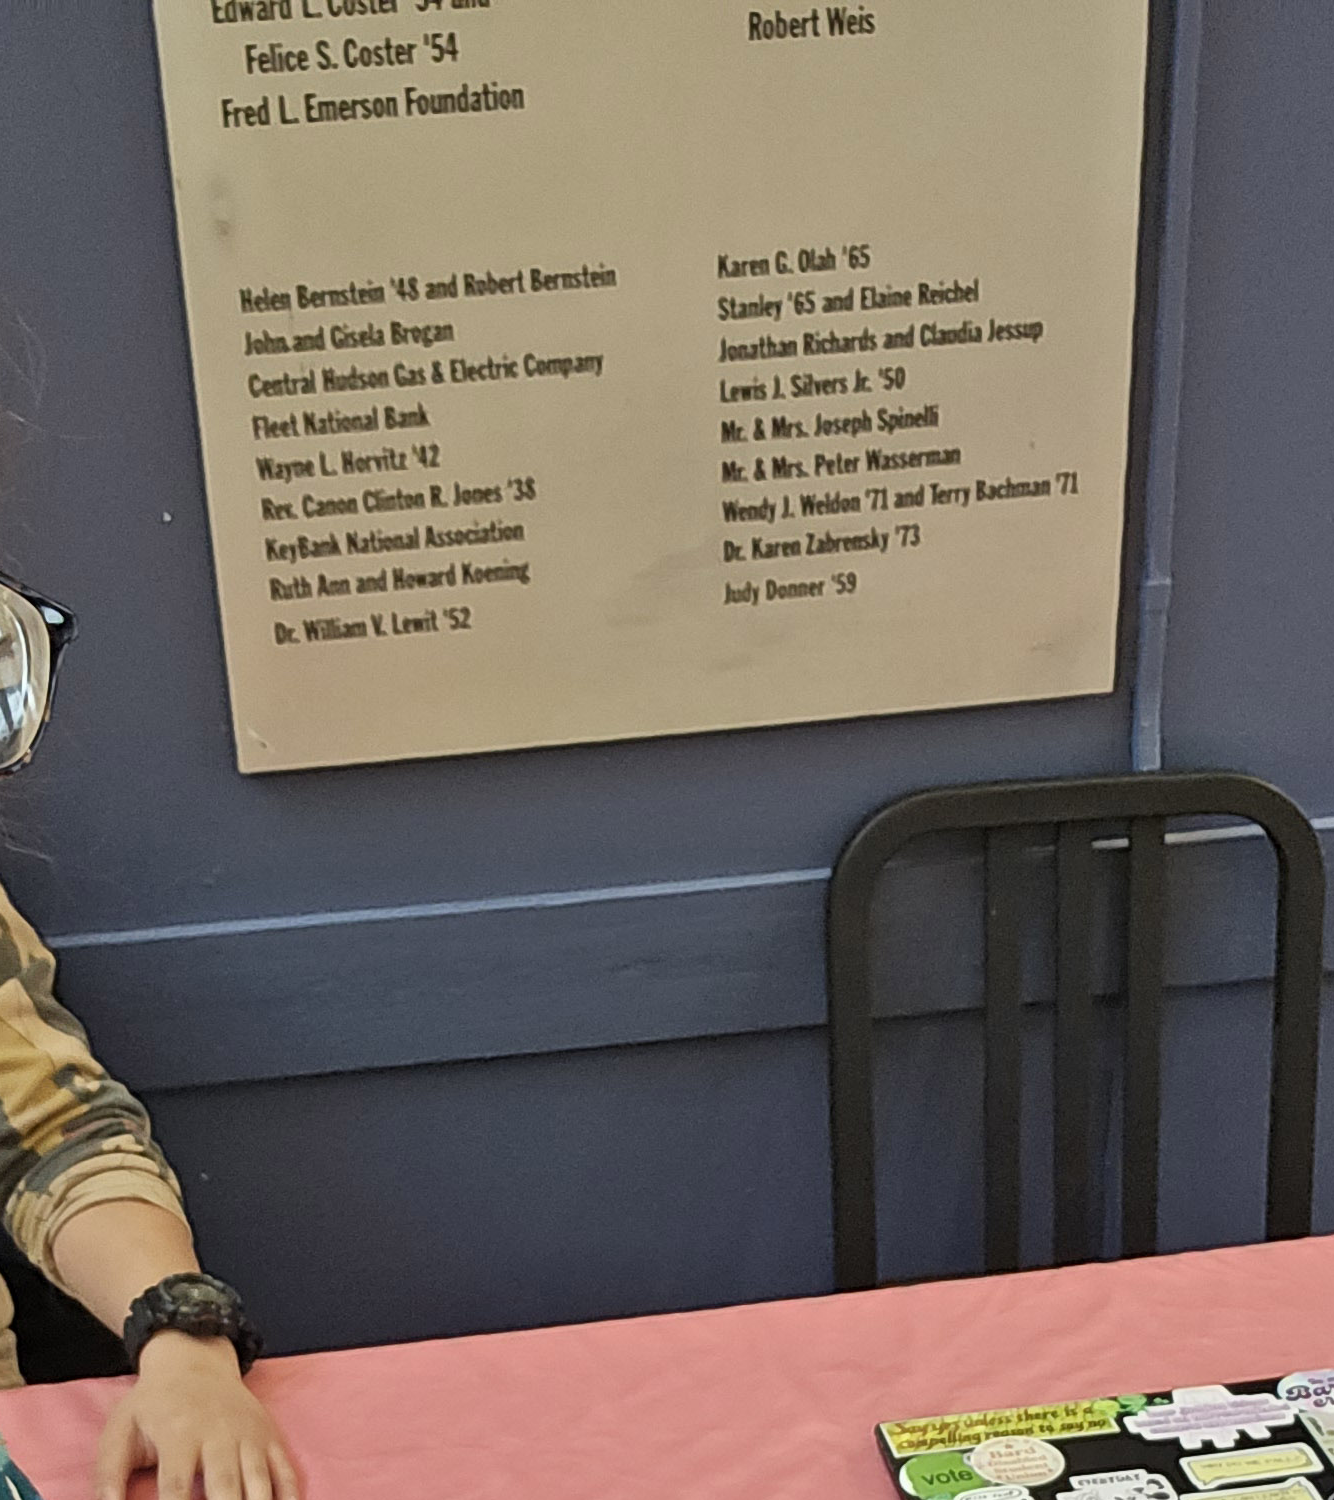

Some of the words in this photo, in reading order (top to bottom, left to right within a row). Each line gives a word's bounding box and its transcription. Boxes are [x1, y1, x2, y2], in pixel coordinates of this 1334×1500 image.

[748, 9, 820, 41] Robert
[826, 5, 875, 36] Weis
[245, 43, 309, 74] Felice
[316, 40, 339, 69] S.
[343, 37, 417, 68] Coster
[423, 32, 458, 62] '54
[221, 96, 270, 128] Fred
[279, 95, 299, 124] L.
[305, 93, 399, 122] Emerson
[405, 82, 525, 116] Foundation
[717, 253, 769, 279] Karen
[775, 250, 793, 275] G.
[798, 248, 835, 273] Olah
[842, 244, 870, 270] '65
[239, 287, 291, 313] Helen
[297, 281, 385, 309] Bernstein
[426, 273, 458, 299] and
[464, 270, 524, 297] Robert
[530, 262, 617, 292] Bernstein
[717, 293, 782, 321] Stanley
[787, 290, 816, 315] '65
[821, 287, 854, 313] and
[860, 284, 913, 311] Elaine
[918, 278, 980, 305] Reichel
[245, 330, 289, 356] John
[293, 327, 325, 352] and
[330, 323, 385, 349] Gisela
[718, 336, 798, 362] Jonathan
[803, 328, 877, 357] Richards
[883, 325, 915, 350] and
[920, 321, 982, 347] Claudia
[988, 318, 1043, 343] Jessup
[249, 370, 317, 398] Central
[322, 366, 389, 392] Hudson
[393, 363, 426, 387] Gas
[432, 360, 446, 384] &
[451, 354, 518, 383] Electric
[523, 353, 604, 379] Company
[720, 376, 766, 402] Lewis
[773, 374, 786, 400] J.
[791, 372, 848, 398] Silvers
[853, 368, 872, 393] Jr.
[879, 366, 906, 390] '50
[252, 414, 298, 440] Fleet
[303, 406, 379, 434] National
[384, 402, 431, 430] Bank
[721, 420, 748, 444] Mr.
[753, 418, 765, 441] &
[771, 416, 809, 439] Mrs.
[814, 410, 872, 437] Joseph
[877, 405, 939, 433] Spinelli
[256, 456, 316, 484] Wayne
[319, 452, 337, 477] L.
[411, 443, 440, 469] '42
[721, 461, 748, 483] Mr.
[754, 458, 766, 481] &
[772, 456, 809, 479] Mrs.
[815, 452, 860, 477] Peter
[866, 448, 961, 472] Wasserman
[261, 497, 298, 521] Rev.
[302, 494, 358, 518] Canon
[362, 487, 425, 514] Clinton
[430, 484, 448, 509] R.
[454, 482, 503, 506] Jones
[722, 498, 776, 524] Wendy
[781, 496, 795, 519] J.
[800, 492, 861, 517] Weldon
[865, 488, 889, 511] '71
[894, 484, 924, 508] and
[929, 482, 970, 508] Terry
[975, 477, 1051, 501] Bachman
[1056, 471, 1079, 495] '71
[266, 533, 341, 564] KeyBank
[346, 526, 419, 556] National
[425, 519, 524, 549] Association
[723, 540, 747, 562] Dr.
[752, 537, 801, 560] Karen
[895, 523, 920, 548] '73
[269, 575, 312, 601] Ruth
[317, 573, 350, 597] Ann
[356, 568, 388, 593] and
[392, 563, 455, 591] Howard
[724, 581, 759, 606] Judy
[765, 578, 825, 601] Donner
[831, 572, 857, 594] '59
[274, 621, 301, 646] Dr.
[304, 616, 367, 642] William
[371, 613, 388, 637] V.
[442, 606, 472, 631] '52
[1016, 1408, 1059, 1421] there
[897, 1431, 982, 1450] compelling
[921, 1468, 973, 1486] vote
